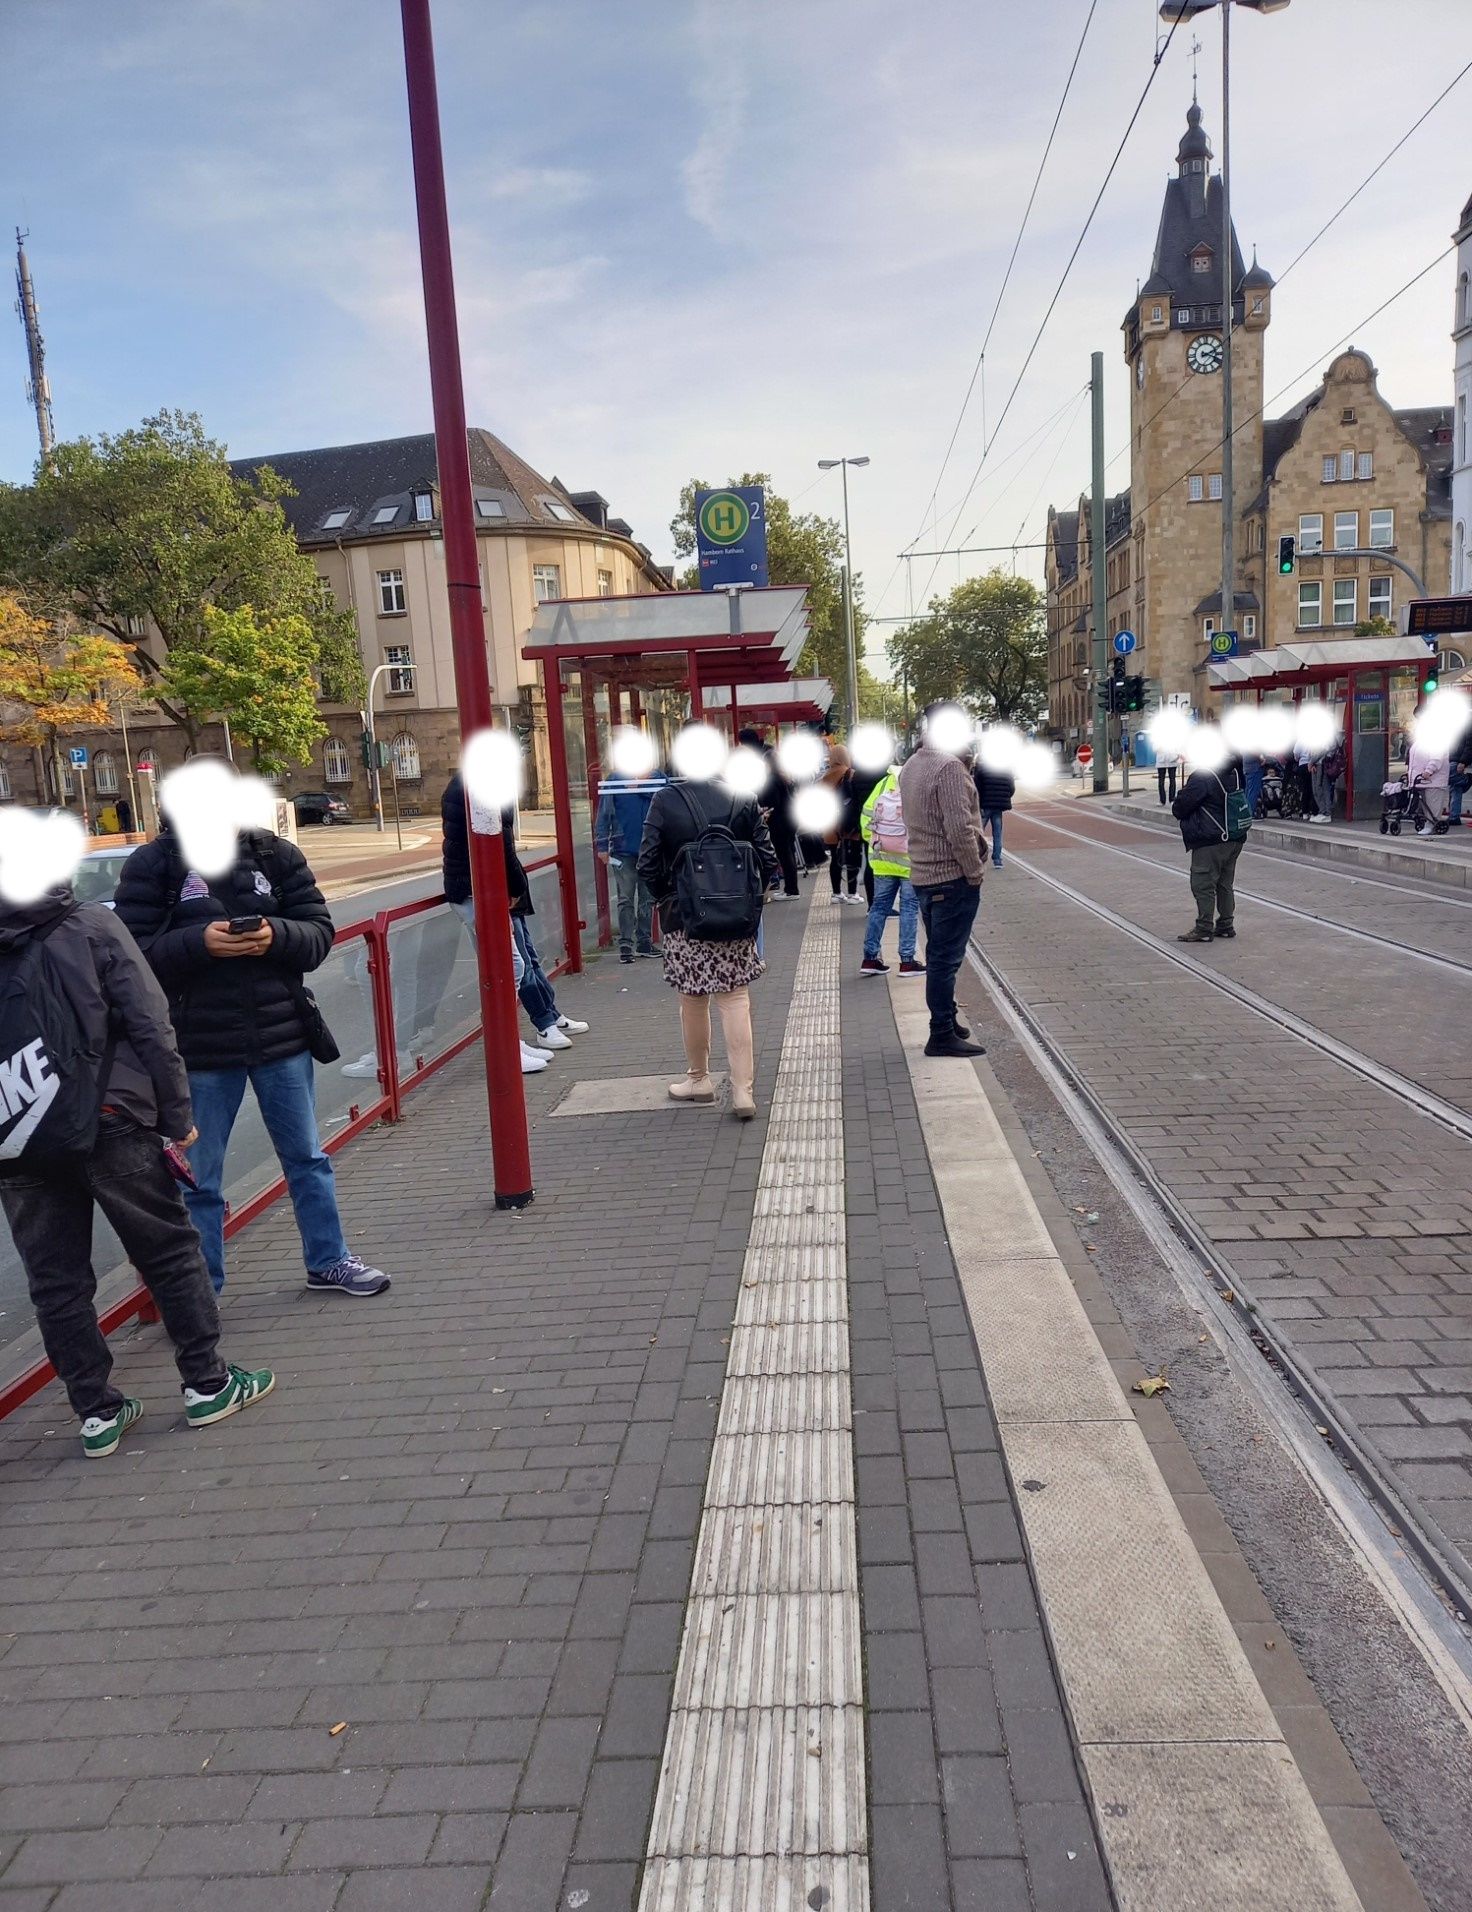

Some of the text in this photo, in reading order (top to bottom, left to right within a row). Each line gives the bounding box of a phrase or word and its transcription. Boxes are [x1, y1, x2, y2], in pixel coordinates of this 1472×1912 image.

[714, 506, 735, 531] H
[750, 501, 761, 520] 2
[1217, 636, 1226, 648] H
[71, 749, 83, 762] P
